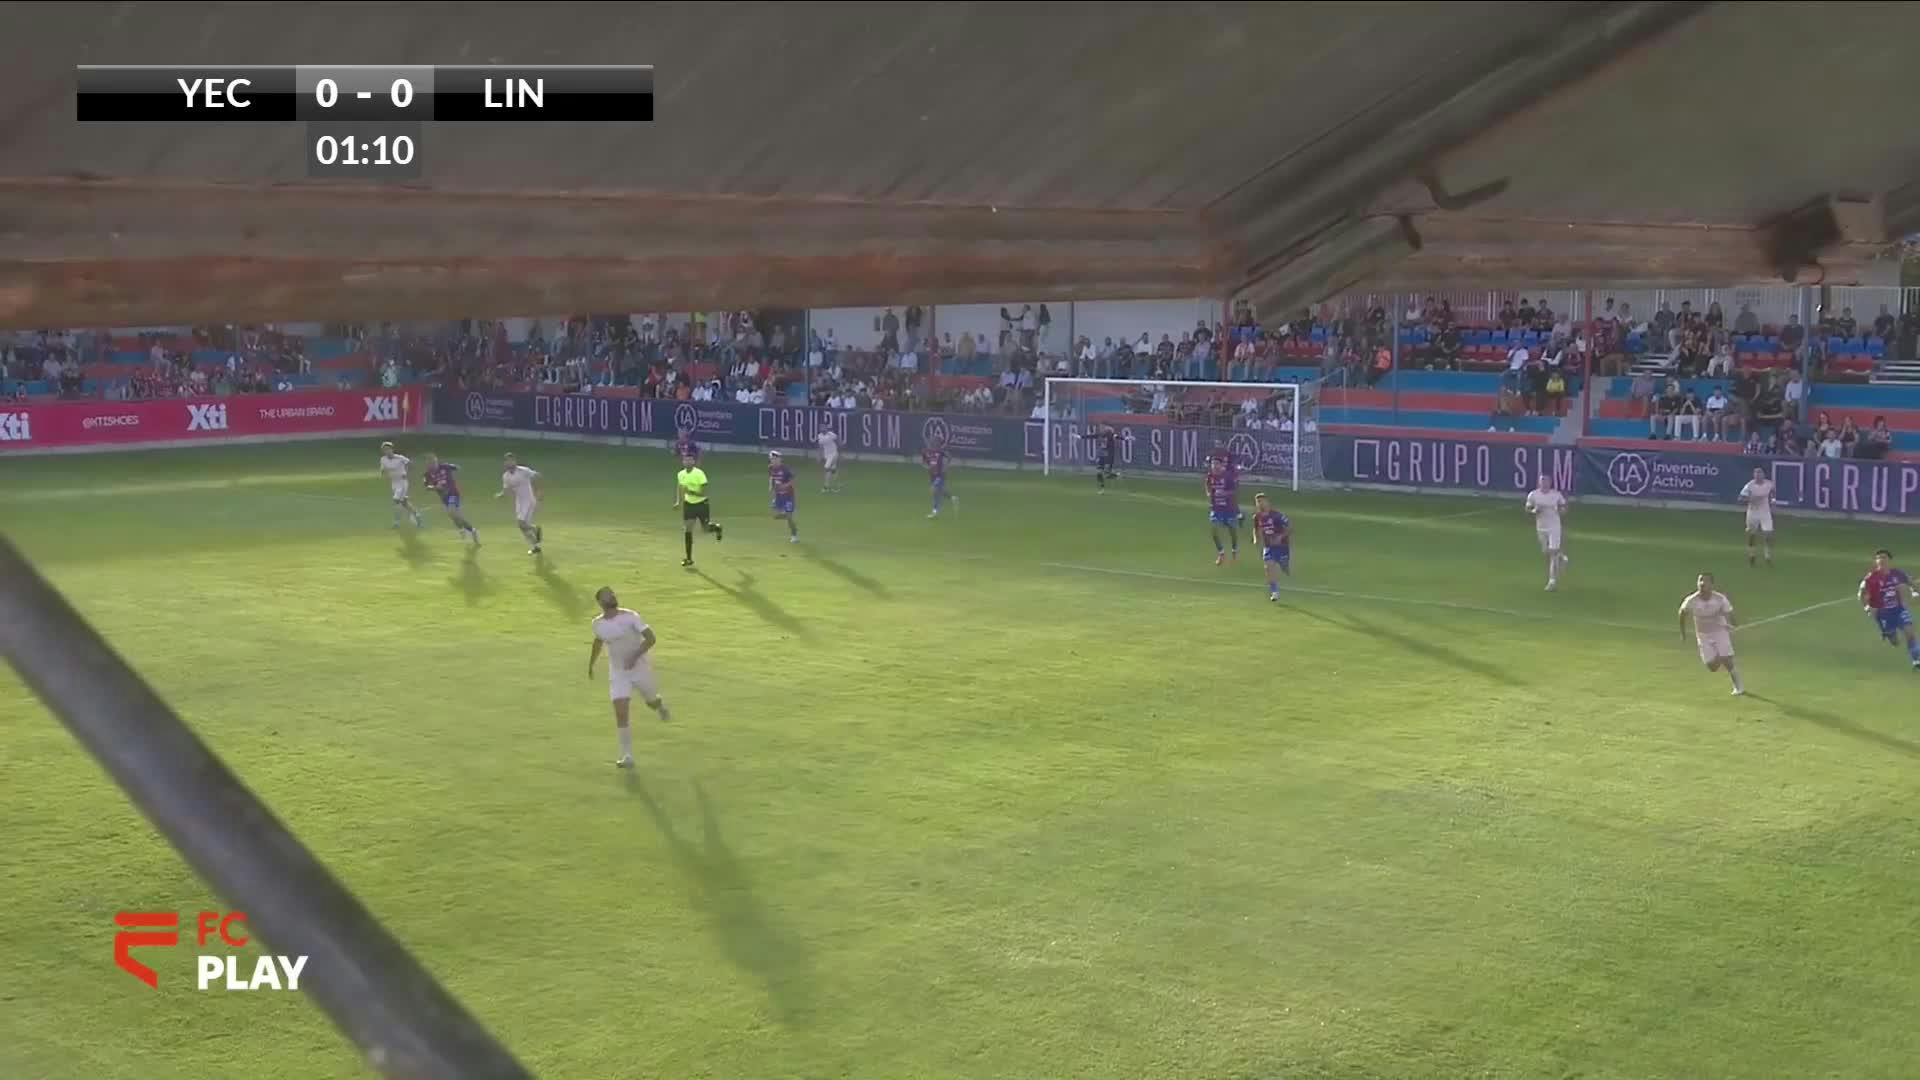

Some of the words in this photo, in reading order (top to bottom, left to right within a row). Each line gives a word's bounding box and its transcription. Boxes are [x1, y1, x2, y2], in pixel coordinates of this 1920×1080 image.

[186, 403, 228, 430] Xti
[259, 408, 276, 419] THE
[306, 406, 335, 417] BRAND
[363, 396, 399, 421] Xti
[553, 395, 608, 430] GRUPO
[620, 400, 652, 432] SIM
[863, 413, 900, 448] SIM
[1152, 428, 1198, 467] SIM
[1235, 442, 1253, 459] IA
[1388, 441, 1489, 486] GRUPO
[1514, 447, 1573, 491] SIM
[1619, 463, 1642, 482] IA
[1653, 462, 1719, 476] Inventario
[1652, 475, 1694, 488] Activo
[1815, 463, 1918, 513] GRUP
